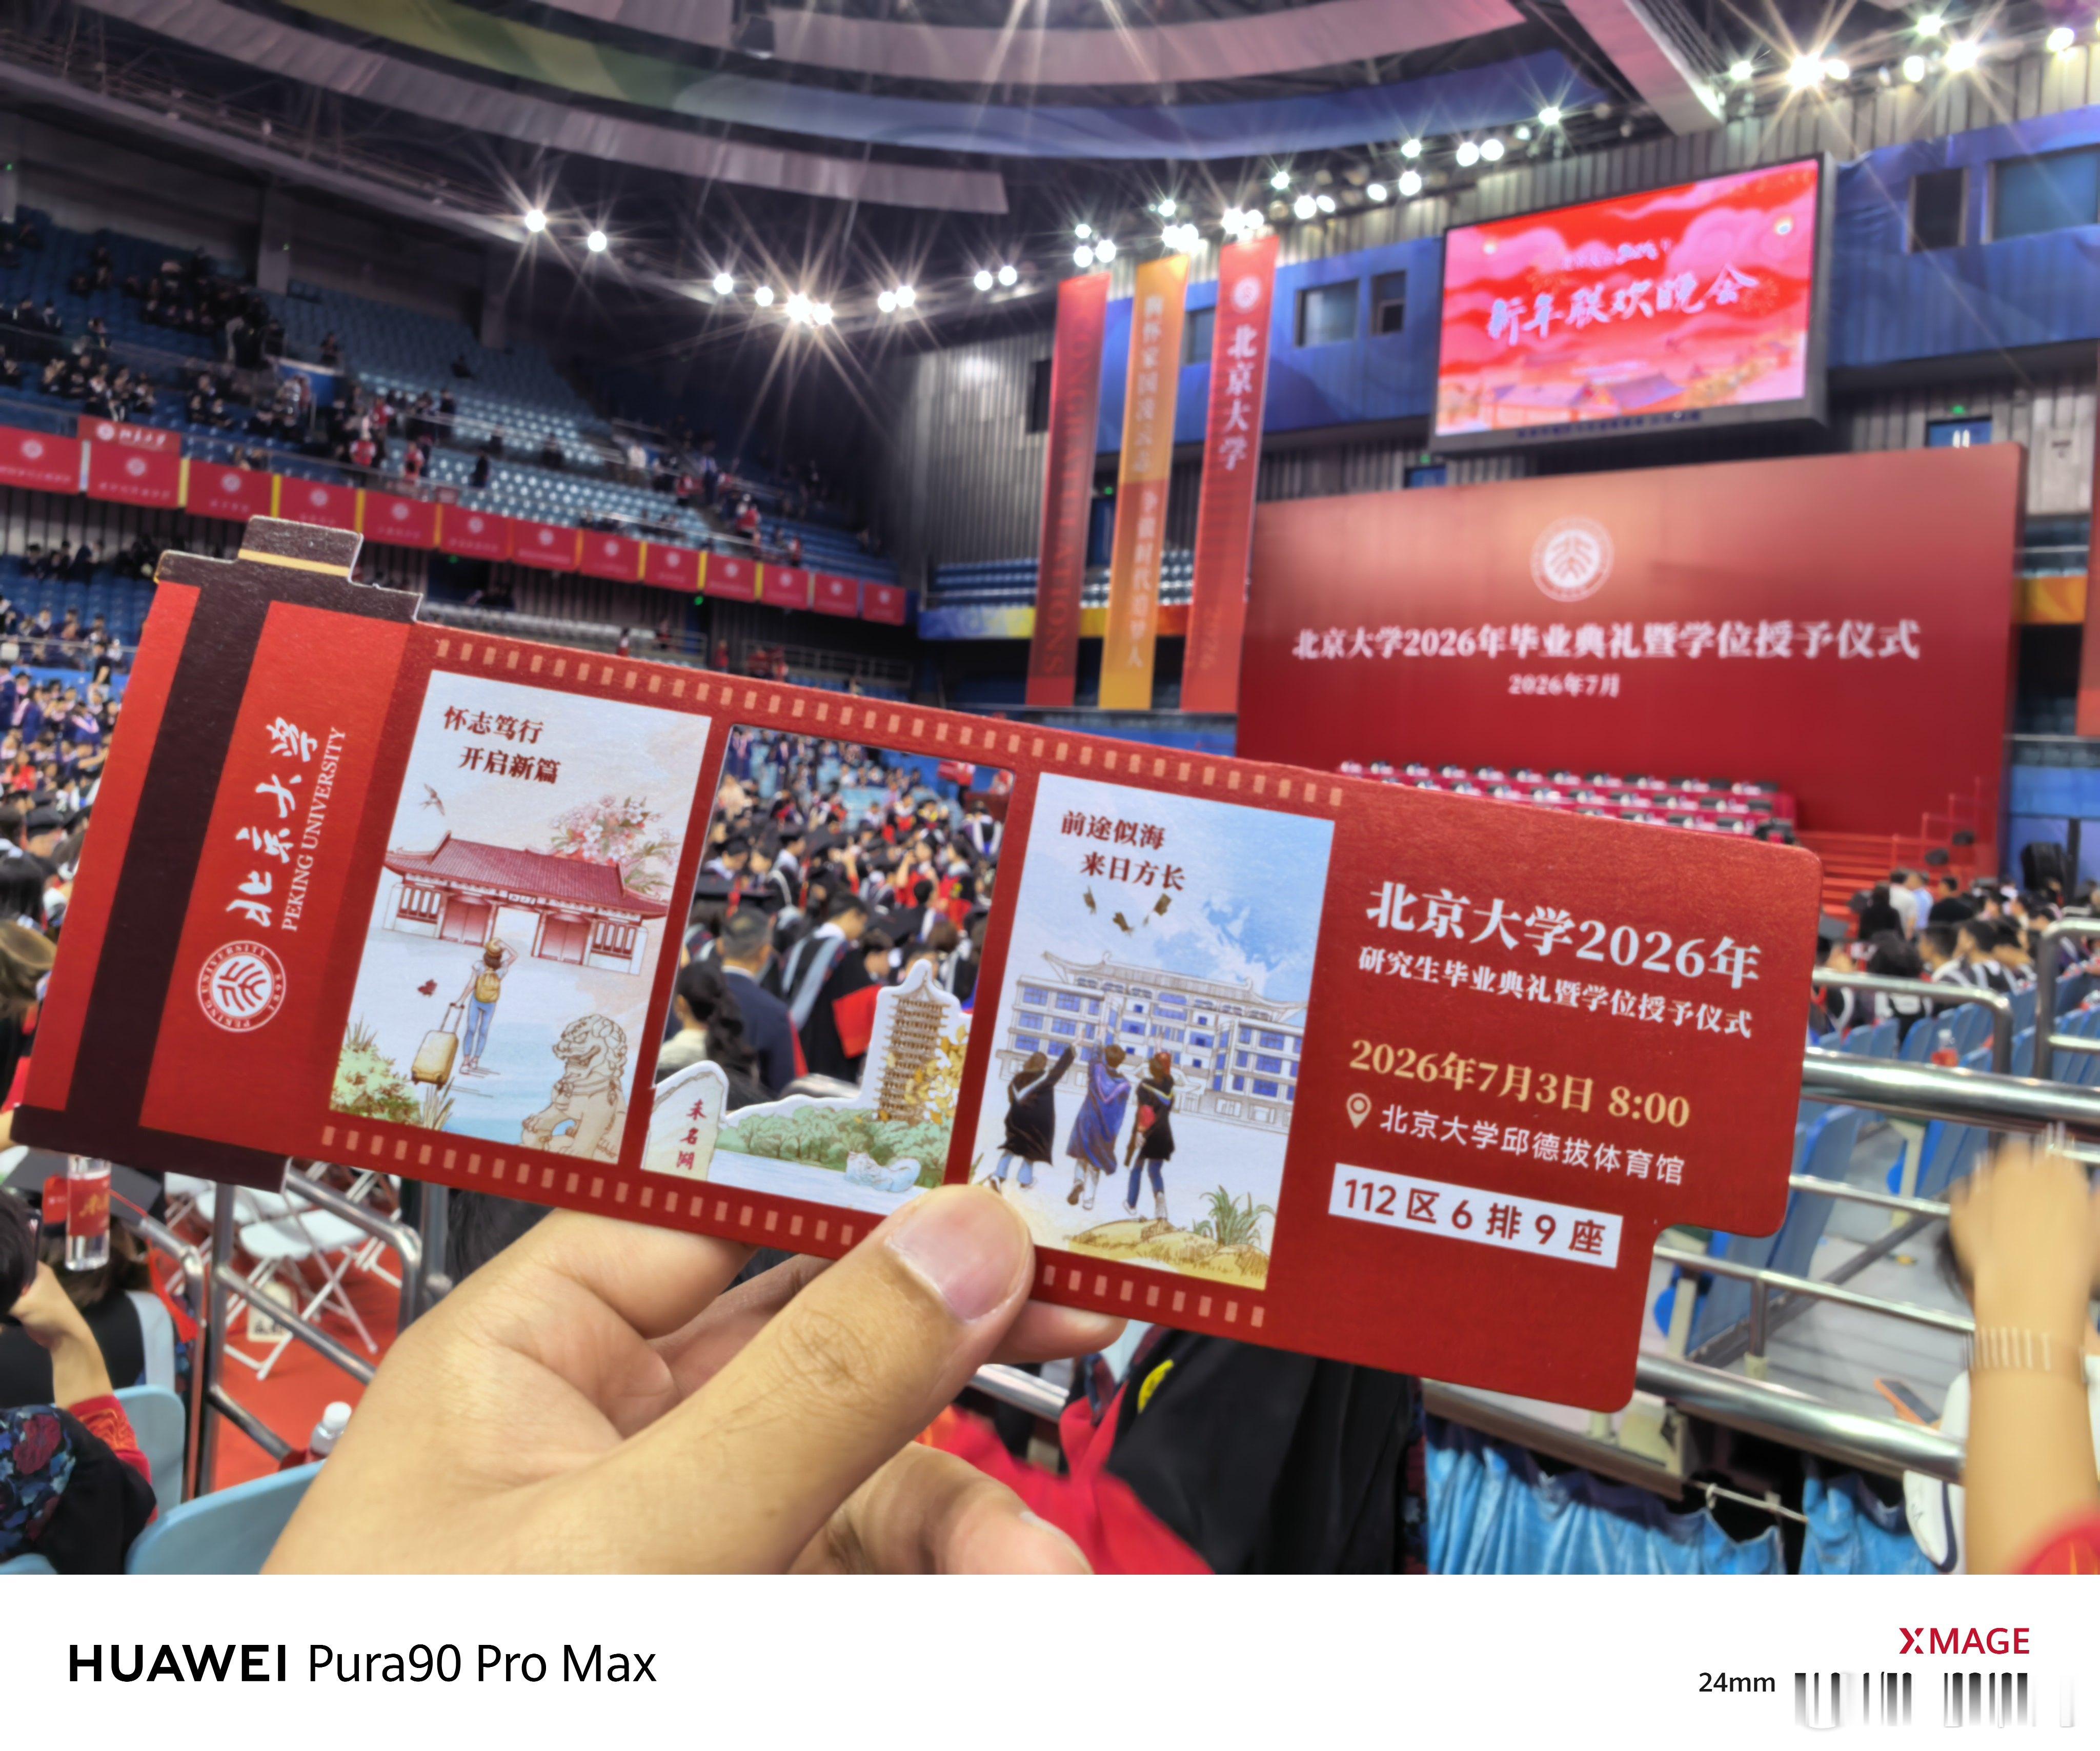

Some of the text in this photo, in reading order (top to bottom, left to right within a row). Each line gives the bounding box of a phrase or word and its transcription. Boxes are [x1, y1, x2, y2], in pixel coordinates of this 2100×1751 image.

[1219, 324, 1258, 471] 北京大学
[1291, 620, 1920, 659] 北京大学2026年毕业典礼暨学位授予仪式
[1508, 672, 1620, 698] 2026年7月
[444, 705, 543, 744] 怀志笃行
[459, 746, 561, 784] 开启新篇
[226, 717, 318, 927] 北京大学
[281, 727, 346, 931] PEKING UNIVERSITY
[1061, 810, 1165, 850] 前途似海
[1080, 851, 1185, 891] 来日方长
[1366, 881, 1761, 989] 北京大学2026年
[1358, 946, 1752, 1039] 研究生毕业典礼暨学位授予仪式
[1349, 1040, 1690, 1127] 2026年7月3日 8:00
[1380, 1104, 1685, 1186] 北京大学邱德拔体育馆
[1345, 1179, 1397, 1216] 112
